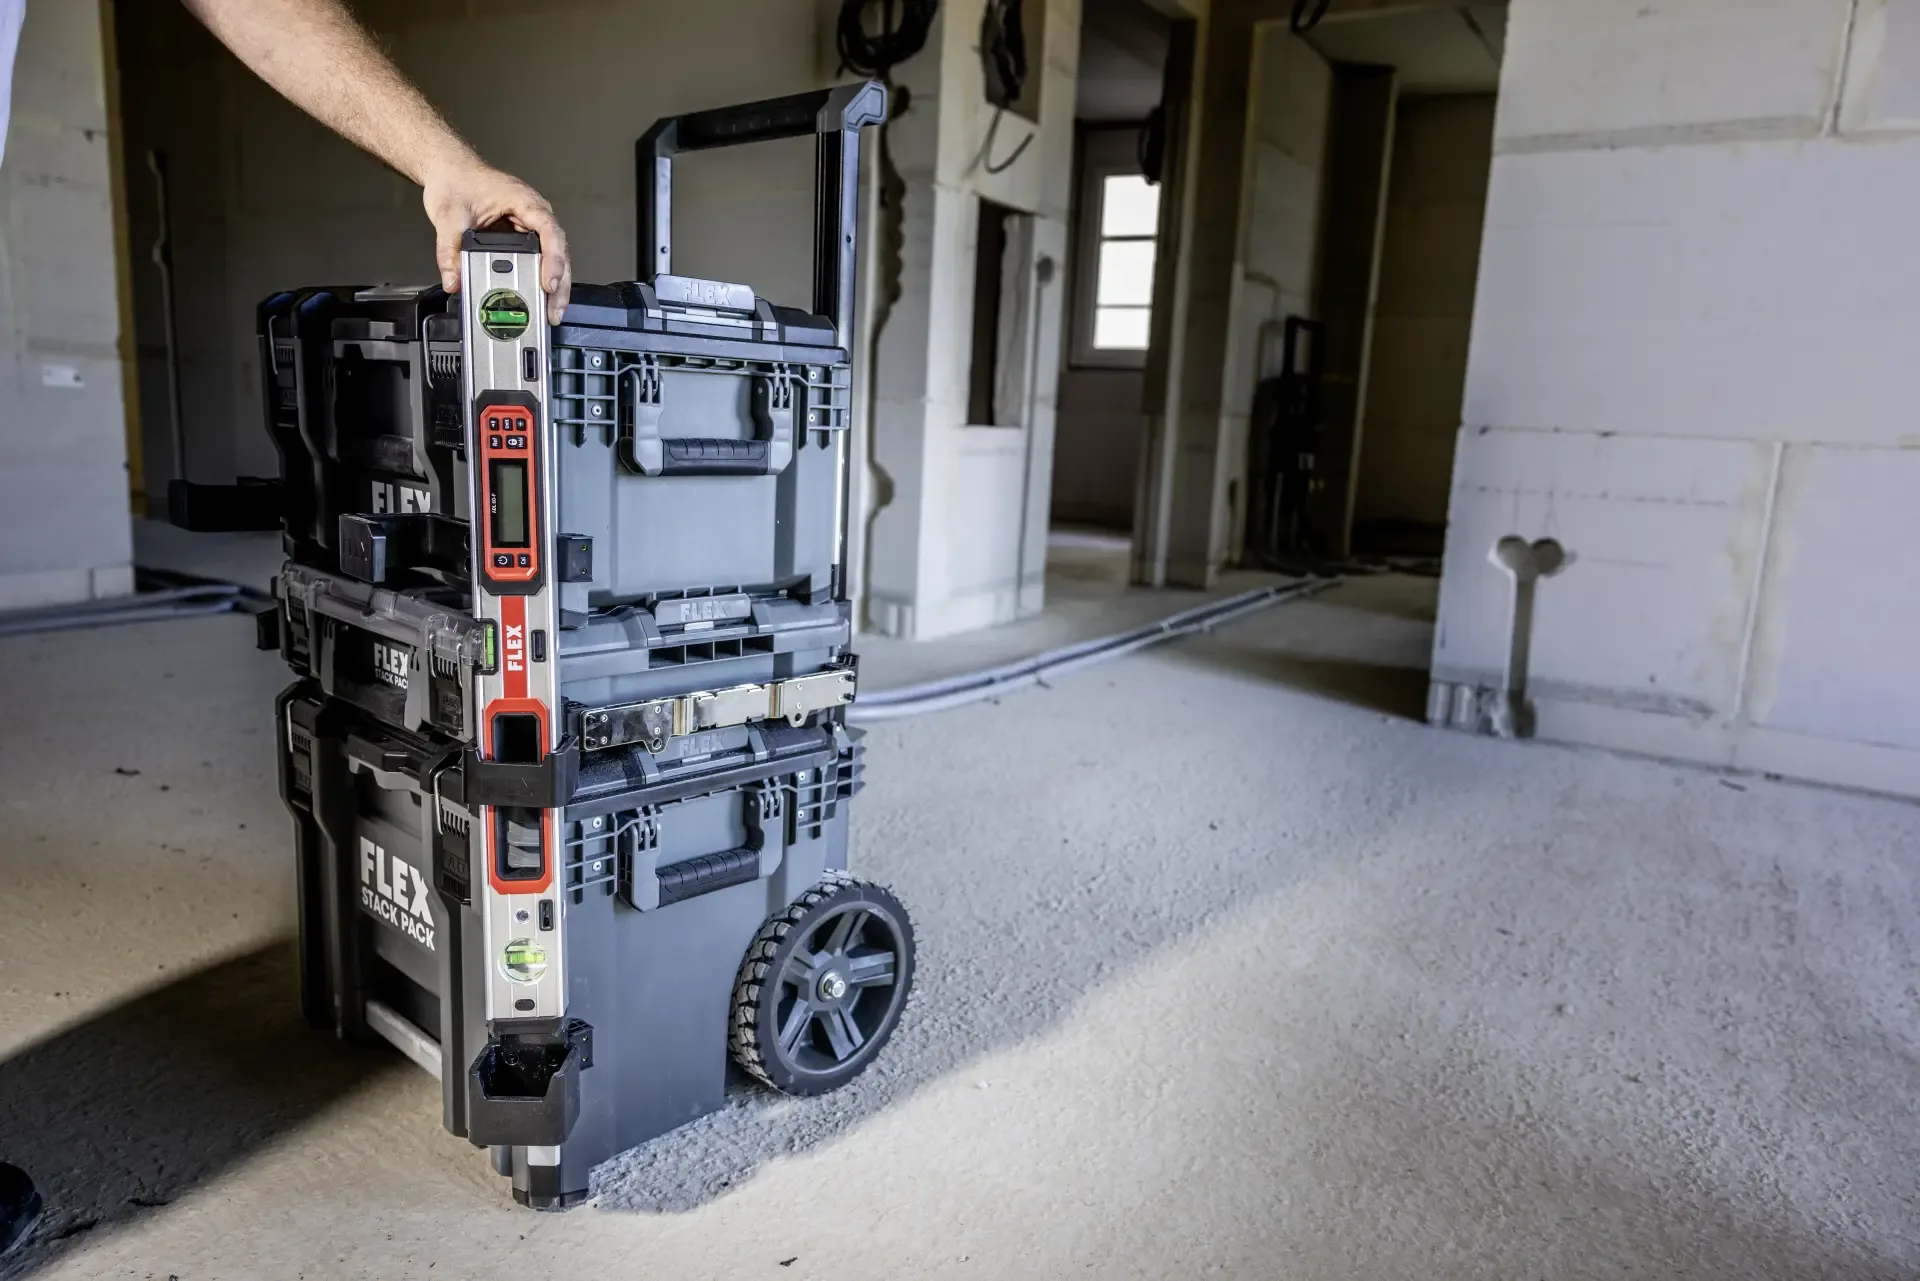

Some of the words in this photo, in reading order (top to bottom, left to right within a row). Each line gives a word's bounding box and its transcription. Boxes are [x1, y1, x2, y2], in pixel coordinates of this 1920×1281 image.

[682, 280, 731, 306] FLEX
[680, 599, 728, 622] FLEX
[373, 641, 408, 678] FLEX
[506, 624, 523, 671] FLEX
[375, 667, 394, 685] STACK
[394, 676, 408, 690] PAC
[680, 730, 724, 757] FLEX
[360, 836, 435, 928] FLEX
[361, 886, 399, 927] STACK
[401, 911, 436, 952] PACK
